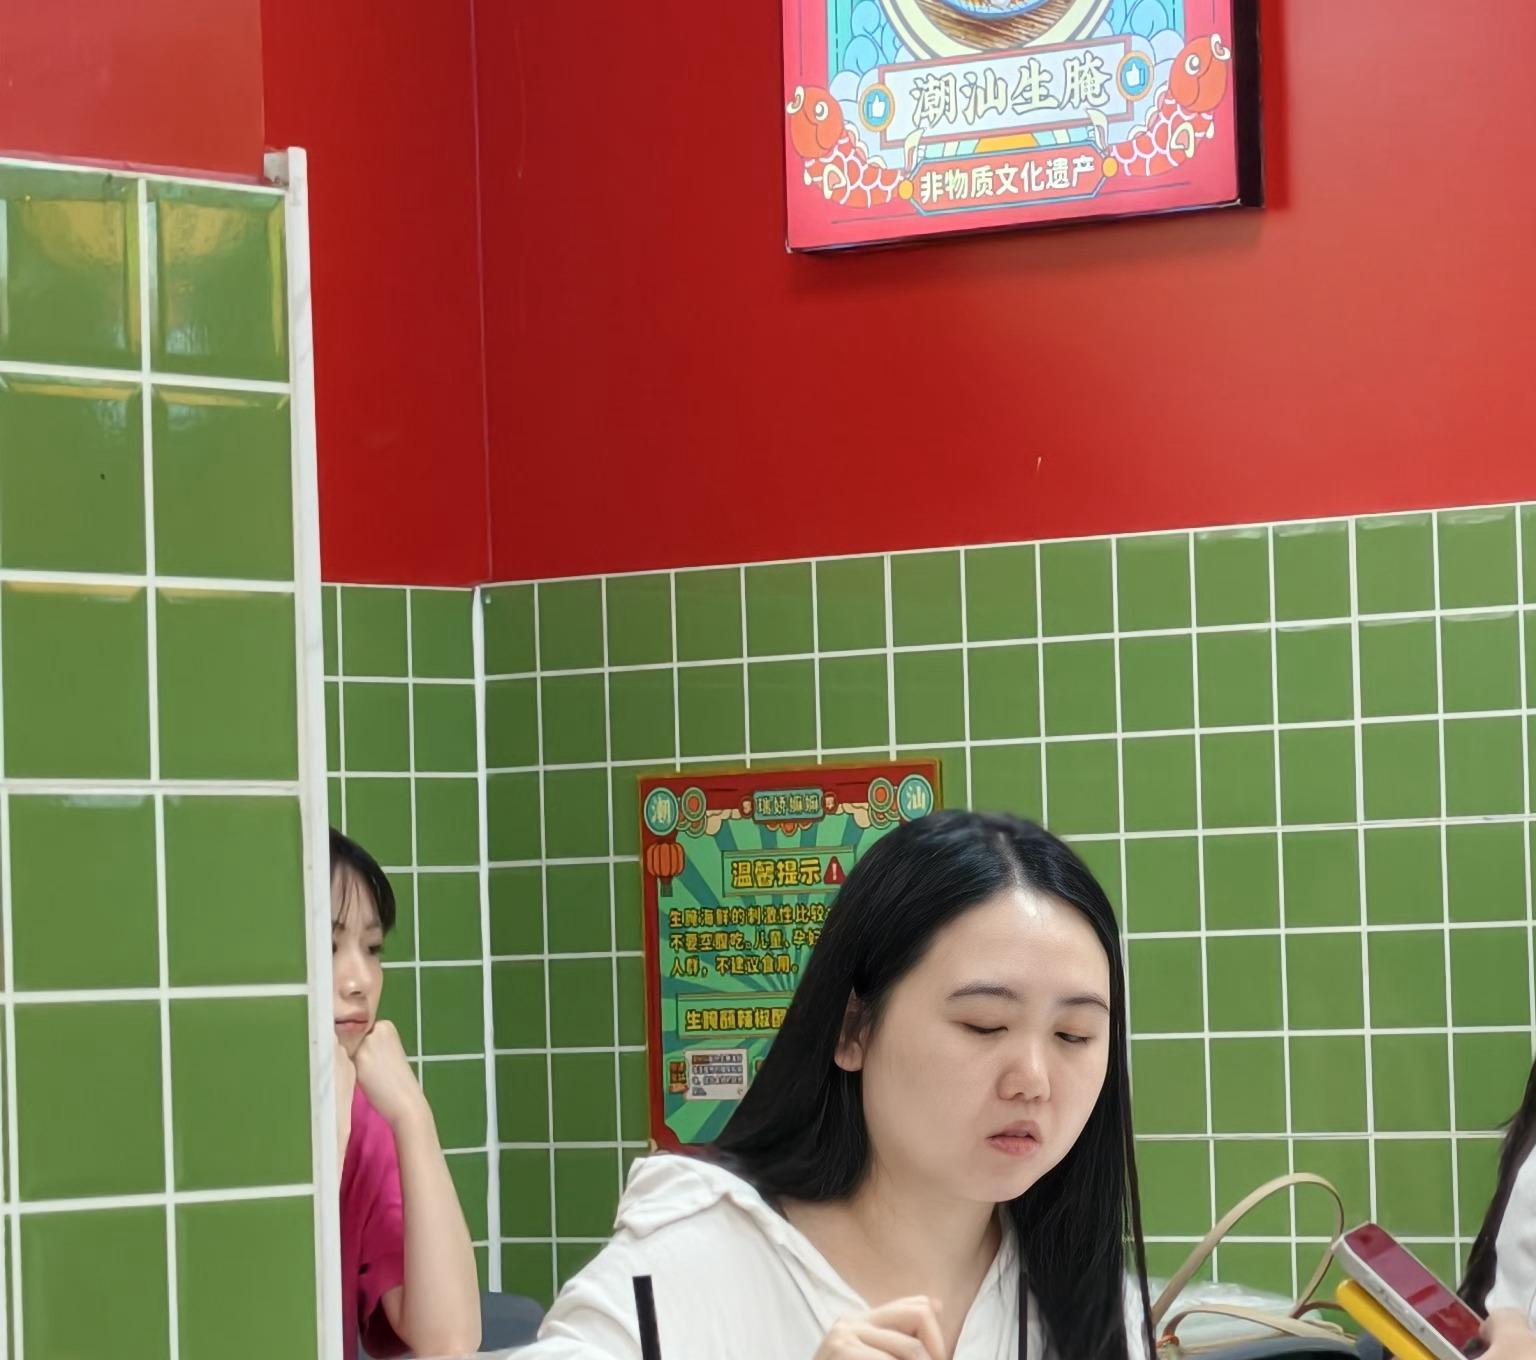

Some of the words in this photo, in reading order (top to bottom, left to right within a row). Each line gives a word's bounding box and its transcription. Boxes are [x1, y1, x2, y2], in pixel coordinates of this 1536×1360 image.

[909, 49, 1113, 129] 潮汕生腌
[920, 154, 1096, 204] 非物质文化遗产
[906, 785, 926, 811] 汕
[731, 857, 822, 888] 温馨提示
[669, 902, 831, 928] 生腌海鲜的刺激性比较
